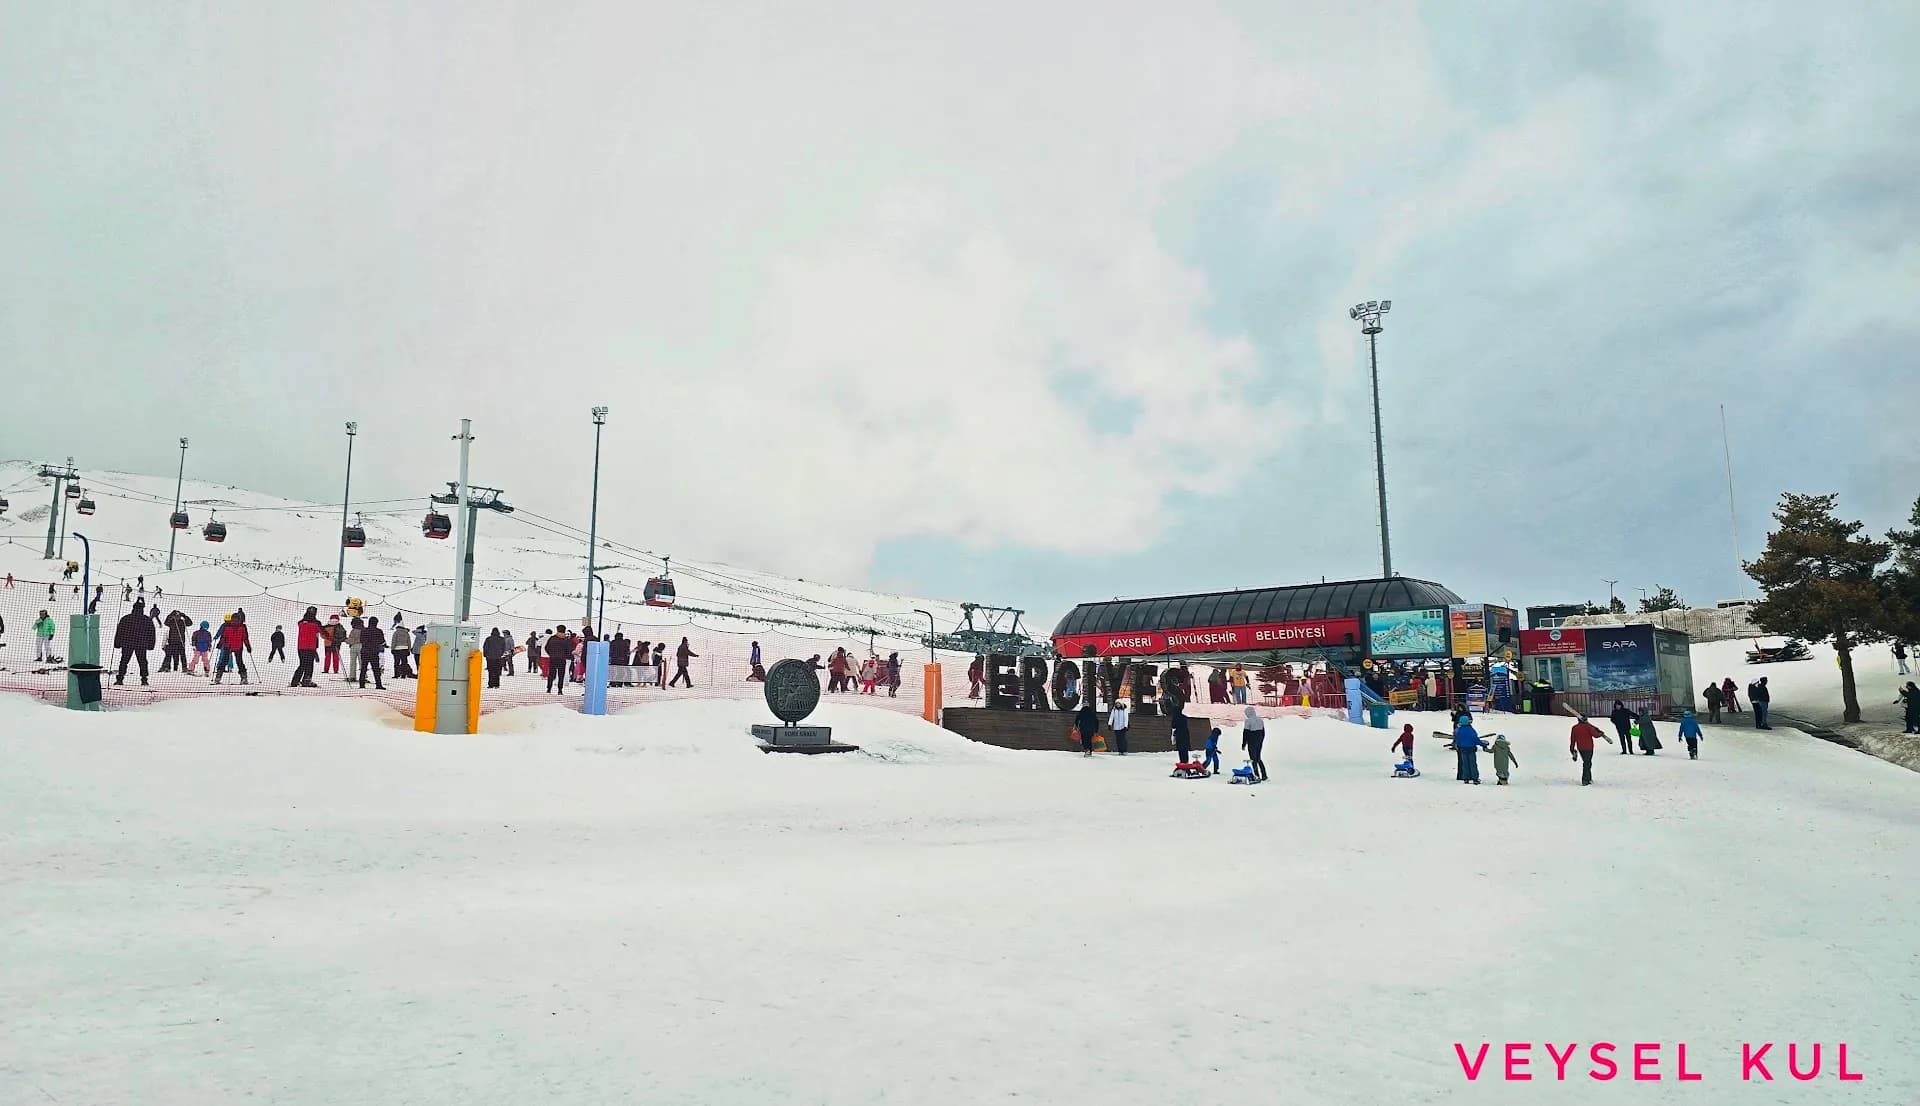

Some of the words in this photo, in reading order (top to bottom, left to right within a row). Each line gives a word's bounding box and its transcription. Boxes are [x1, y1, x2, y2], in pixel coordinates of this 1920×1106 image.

[1109, 637, 1152, 648] KAYSERİ
[1168, 630, 1237, 646] BÜYÜKŞEHİR
[1256, 625, 1326, 641] BELEDİYESİ
[1602, 640, 1637, 649] SAFA
